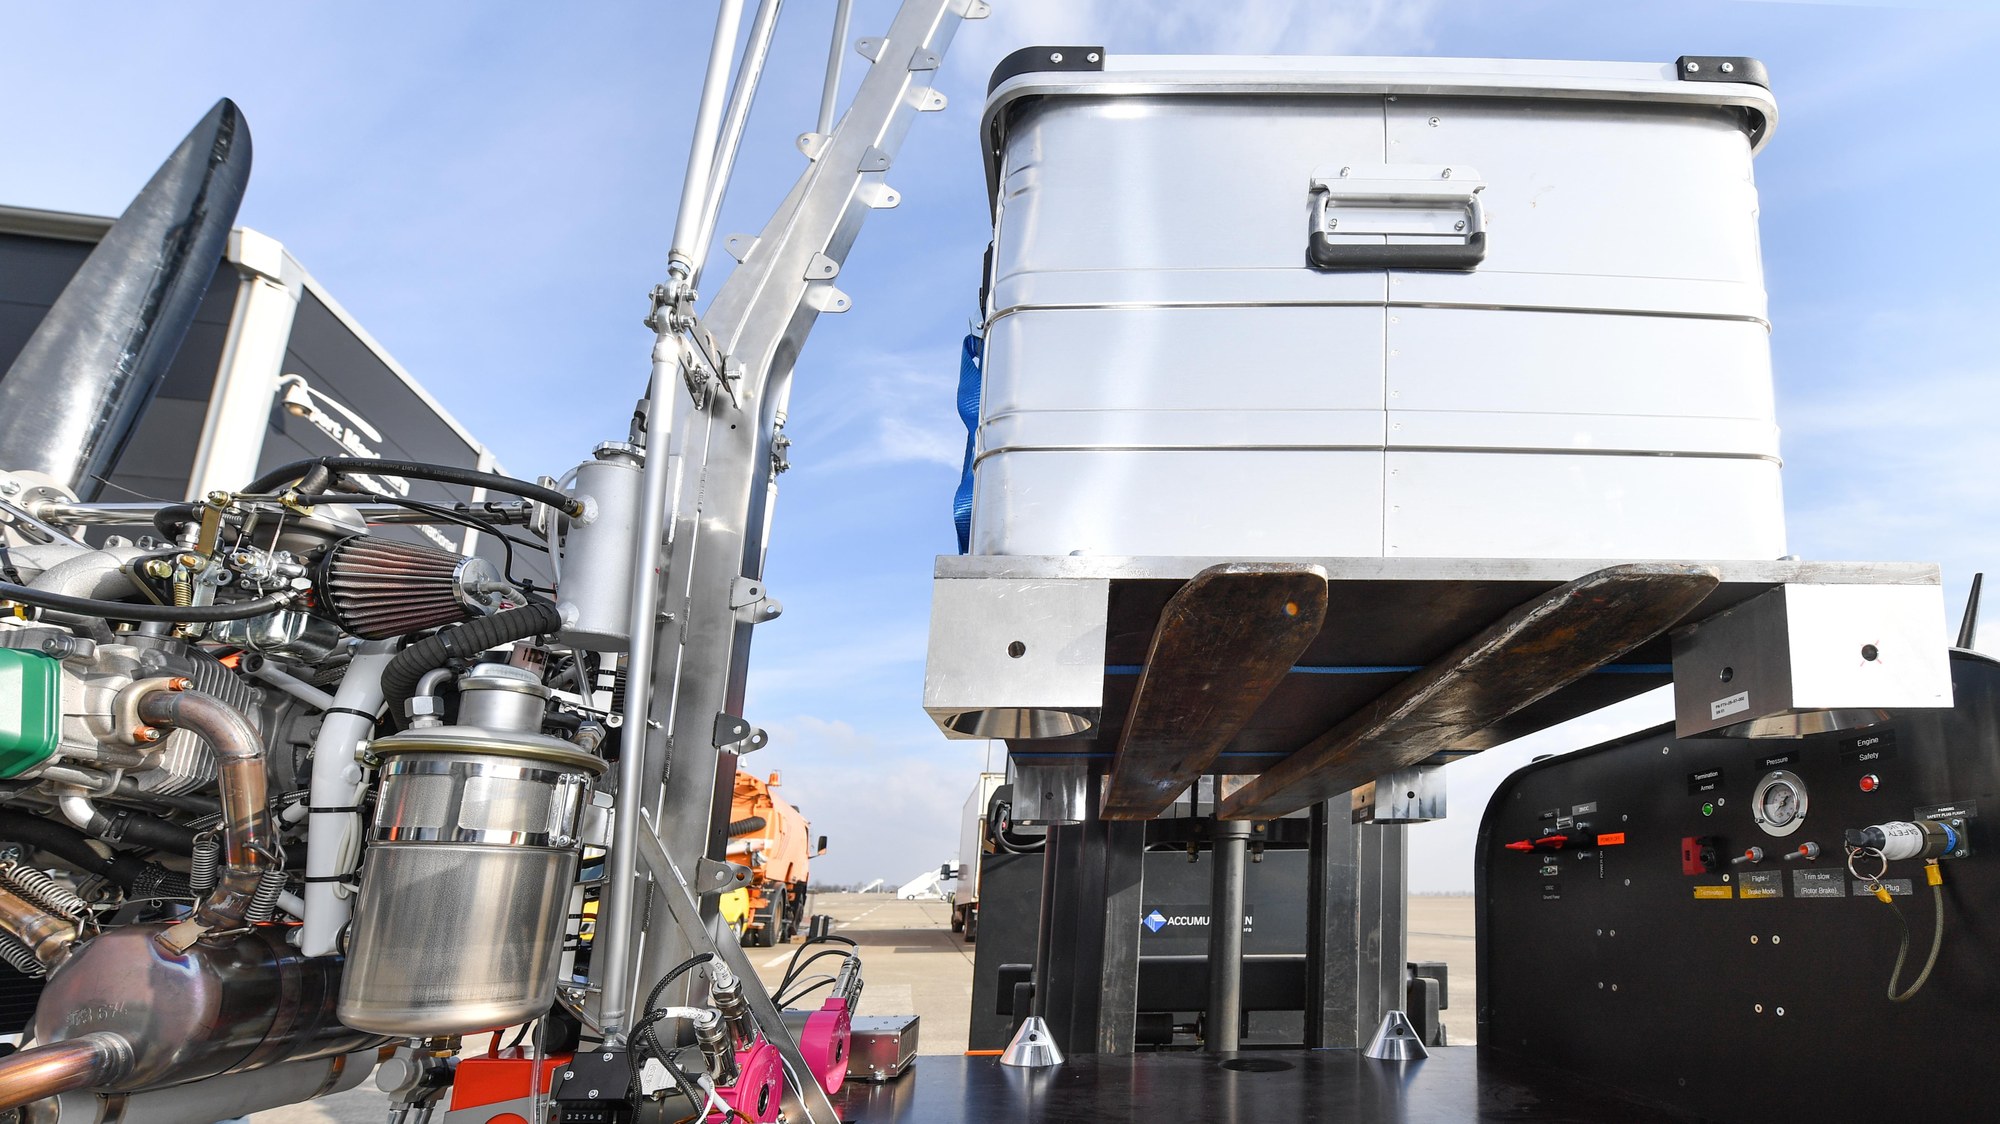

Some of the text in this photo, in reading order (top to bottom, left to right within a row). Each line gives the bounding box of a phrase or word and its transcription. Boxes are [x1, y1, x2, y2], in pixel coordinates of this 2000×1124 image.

[1857, 737, 1879, 747] Engine
[1766, 756, 1789, 766] Pressure
[1859, 752, 1879, 761] Safety
[1694, 771, 1718, 781] Termination
[1700, 783, 1714, 791] Armed
[1889, 828, 1919, 837] SAFETY
[1800, 887, 1818, 895] (Rotor
[1885, 884, 1900, 892] Plug
